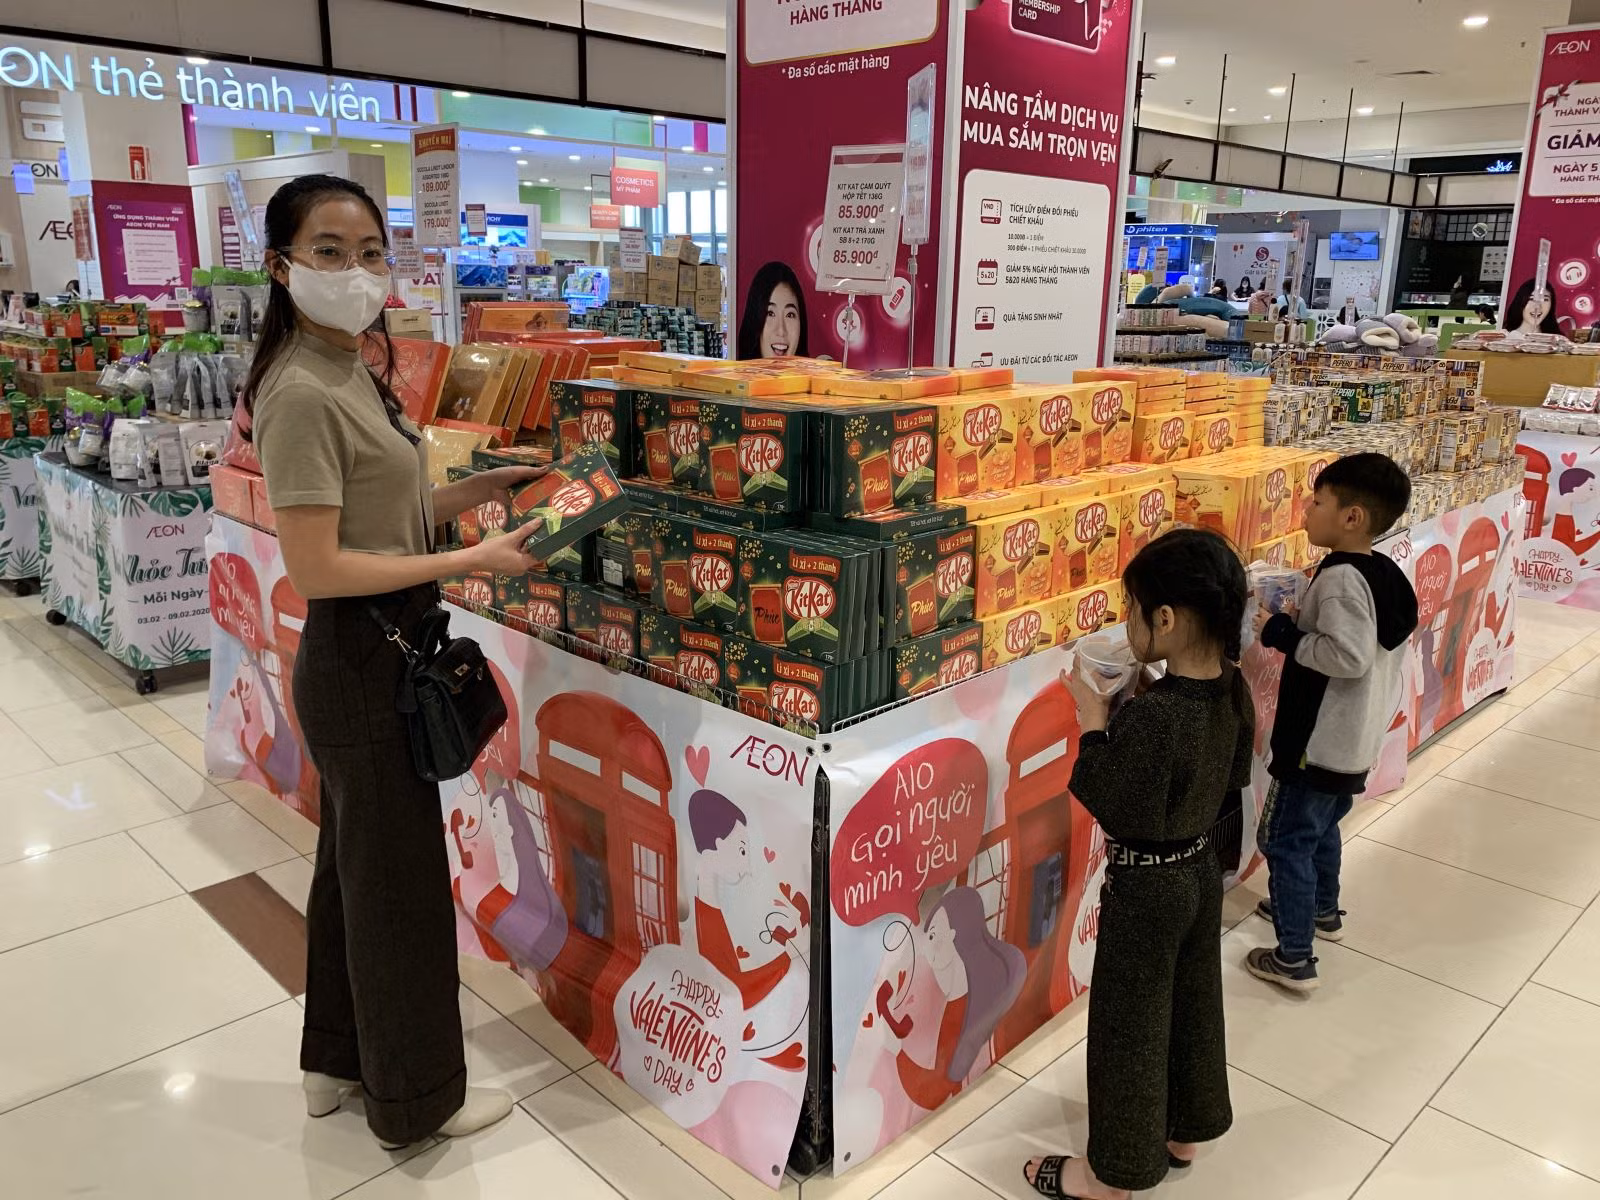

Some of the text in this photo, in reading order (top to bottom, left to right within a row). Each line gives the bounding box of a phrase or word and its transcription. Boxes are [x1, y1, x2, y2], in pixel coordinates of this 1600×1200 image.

[790, 5, 829, 25] HÀNG
[1018, 7, 1038, 20] CARD
[788, 54, 890, 79] Đa số các mặt hàng
[91, 57, 165, 101] thẻ
[176, 67, 294, 114] thành
[309, 82, 381, 122] viên
[964, 81, 1119, 139] NÂNG TẦM DỊCH VỤ
[963, 120, 1117, 166] MUA SẮM TRỌN VẸN
[1547, 129, 1600, 150] GIẢM
[1553, 161, 1598, 174] NGÀY 5
[615, 176, 655, 187] COSMETICS
[1560, 173, 1586, 183] HÀNG
[1010, 203, 1024, 213] TÍCH
[867, 227, 885, 235] XANH
[1136, 225, 1168, 234] phiten
[1022, 265, 1031, 273] 5%
[1032, 263, 1047, 274] NGÀY
[1020, 274, 1037, 284] HÀNG
[1038, 275, 1058, 284] THÁNG
[1003, 312, 1016, 323] QUÀ
[1033, 313, 1047, 321] SINH
[1064, 354, 1079, 362] AEON
[1331, 359, 1354, 367] PEPERO
[1382, 362, 1405, 370] PEPERO
[743, 438, 778, 472] KitKat
[898, 436, 929, 473] KitKat
[717, 538, 733, 550] thanh
[695, 558, 728, 592] KitKat
[813, 561, 817, 569] 2
[818, 561, 837, 574] thanh
[942, 557, 970, 594] KitKat
[1533, 580, 1550, 593] DAY
[143, 587, 204, 605] Mỗi Ngày
[791, 581, 830, 618] KitKat
[137, 616, 160, 625] 03.02
[776, 662, 782, 673] Lì
[783, 663, 790, 675] xì
[796, 669, 801, 677] 2
[801, 670, 819, 683] thanh
[851, 782, 976, 863] Gọi người
[844, 835, 958, 916] mình yêu
[670, 969, 723, 1019] HAPPY
[630, 981, 726, 1083] VALENTINE'S
[653, 1058, 683, 1096] DAY
